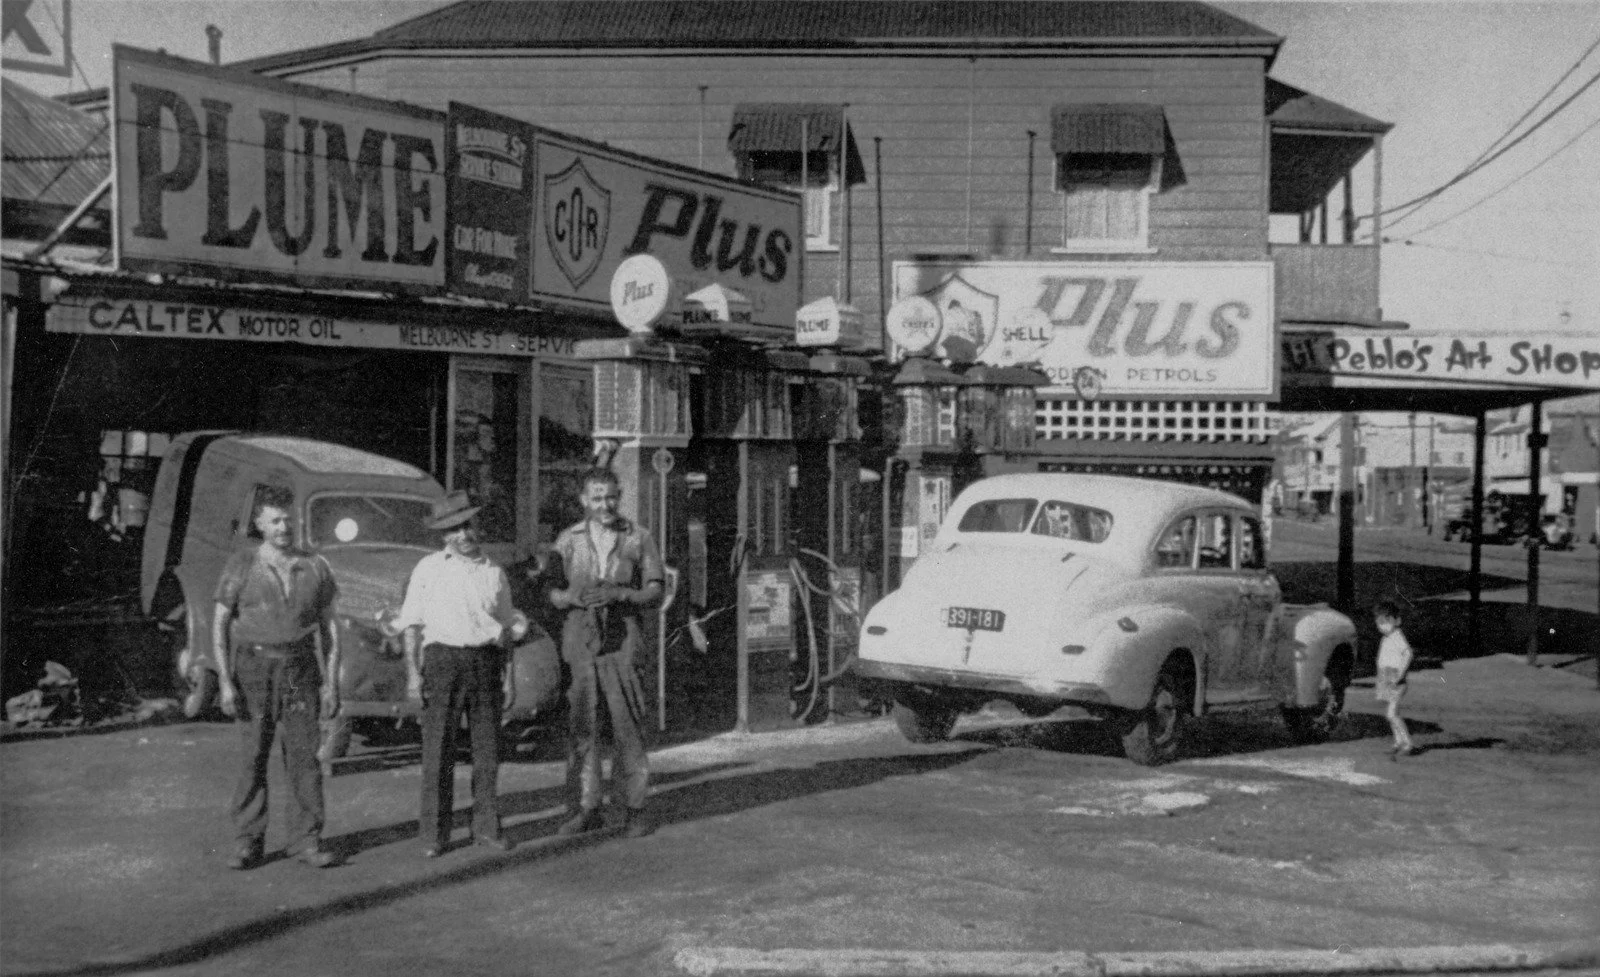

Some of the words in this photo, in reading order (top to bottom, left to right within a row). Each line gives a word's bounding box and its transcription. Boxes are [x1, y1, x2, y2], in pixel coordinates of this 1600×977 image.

[130, 83, 440, 266] PLUME
[554, 187, 599, 262] COR
[623, 181, 793, 283] Plus
[622, 279, 655, 306] Plus
[1035, 274, 1252, 359] Plus
[90, 301, 225, 335] CALTEX
[240, 314, 300, 338] MOTOR
[309, 318, 341, 341] OIL
[399, 323, 477, 349] MELBOURNE
[1002, 325, 1050, 342] SHELL
[1127, 367, 1218, 382] PETROLS
[1444, 339, 1493, 372] Art
